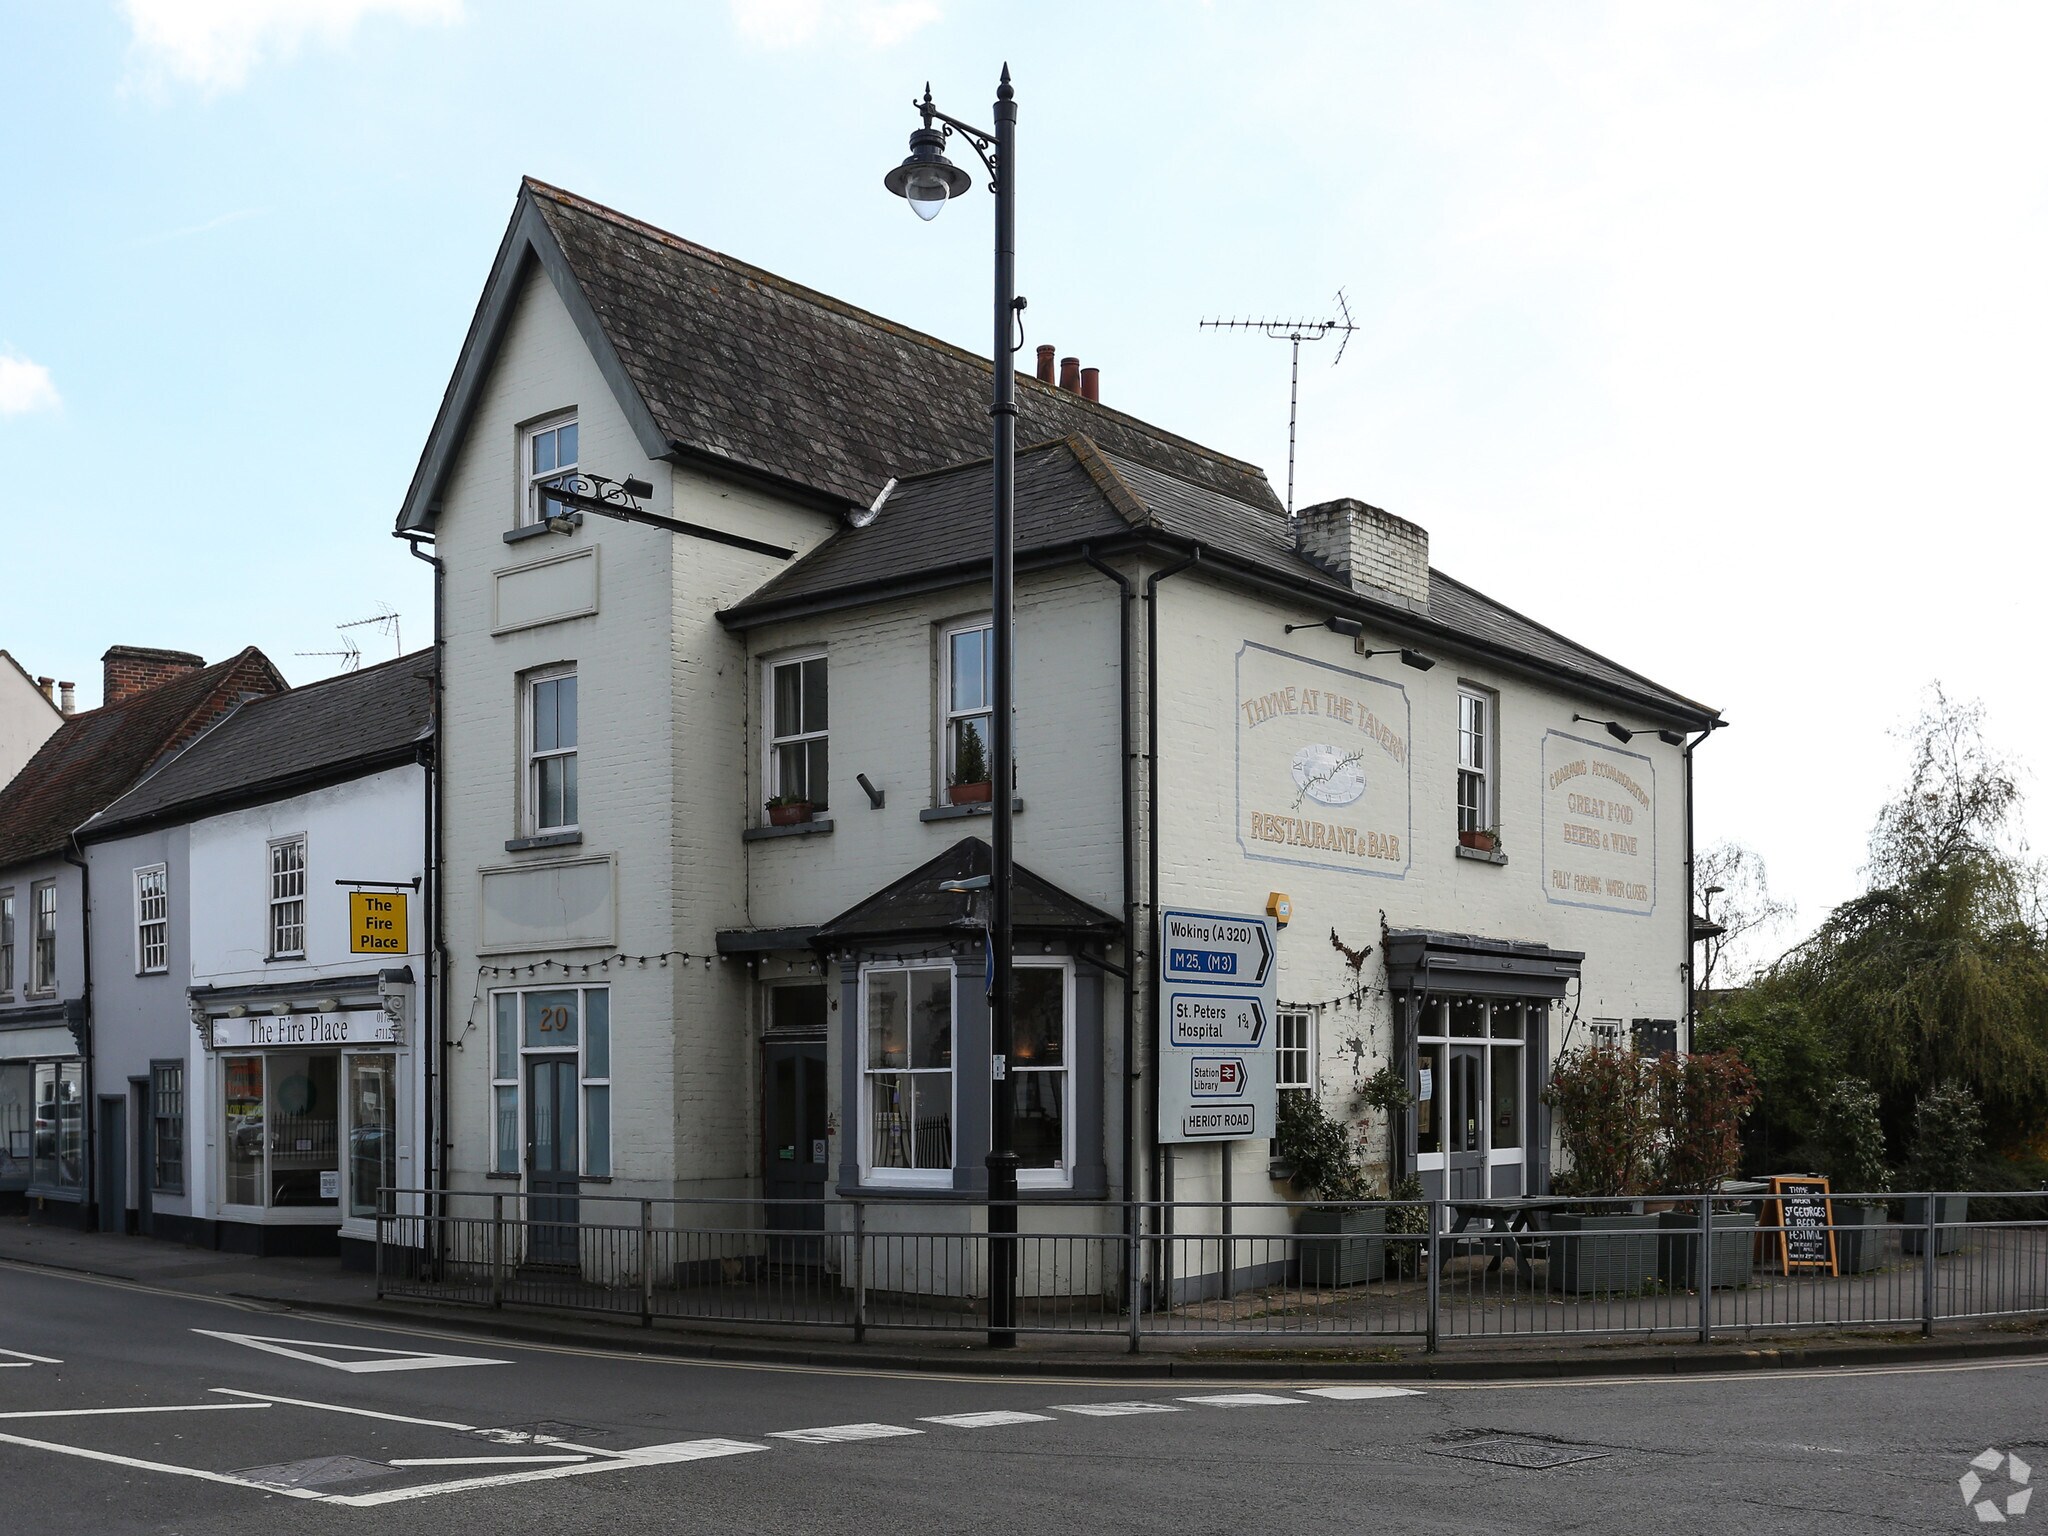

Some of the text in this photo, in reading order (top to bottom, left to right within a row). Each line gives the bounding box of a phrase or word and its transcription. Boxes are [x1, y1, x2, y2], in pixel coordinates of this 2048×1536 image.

[1241, 686, 1408, 768] THYME AT THE TAVERN
[1549, 760, 1587, 790] CHARMING
[1568, 793, 1633, 825] GREAT FOOD
[1251, 811, 1401, 861] RESTAURANT & BAR
[1563, 823, 1637, 856] BEERS & WINE
[1552, 869, 1571, 890] FULLY
[1605, 878, 1625, 898] WATER
[365, 898, 392, 911] The
[366, 917, 392, 929] Fire
[1171, 921, 1209, 942] Woking
[361, 935, 398, 948] Place
[540, 1007, 568, 1031] 20
[1176, 1003, 1226, 1019] St. Peters
[250, 1018, 273, 1043] The
[278, 1016, 305, 1042] Fire
[310, 1014, 348, 1041] Place
[1179, 1022, 1223, 1040] Hospital
[1194, 1067, 1219, 1078] Station
[1194, 1080, 1219, 1092] Library
[1189, 1114, 1249, 1127] HERIOT ROAD
[1796, 1218, 1816, 1227] BEER
